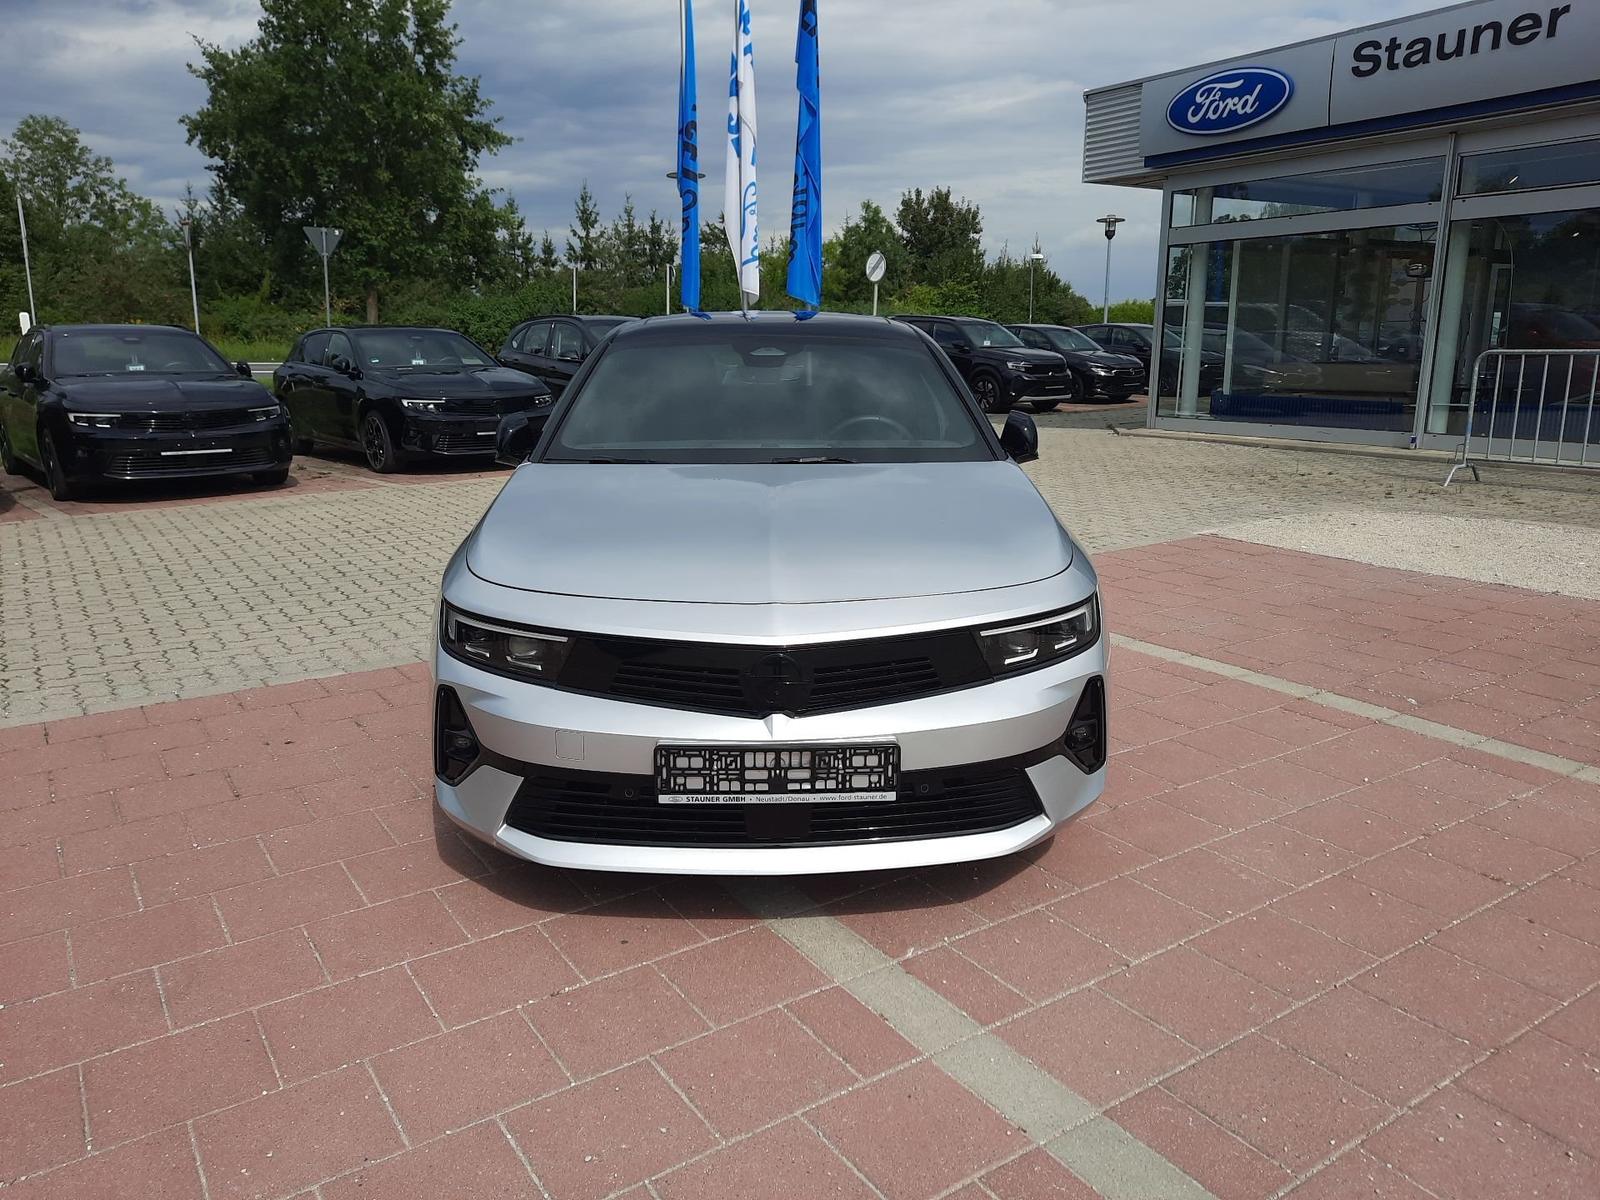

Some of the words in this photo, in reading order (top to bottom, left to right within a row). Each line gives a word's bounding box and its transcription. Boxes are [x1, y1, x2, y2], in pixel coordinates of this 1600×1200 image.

[1351, 3, 1571, 78] Stauner
[1187, 78, 1265, 124] Ford
[755, 795, 810, 803] Neustadt/Donau
